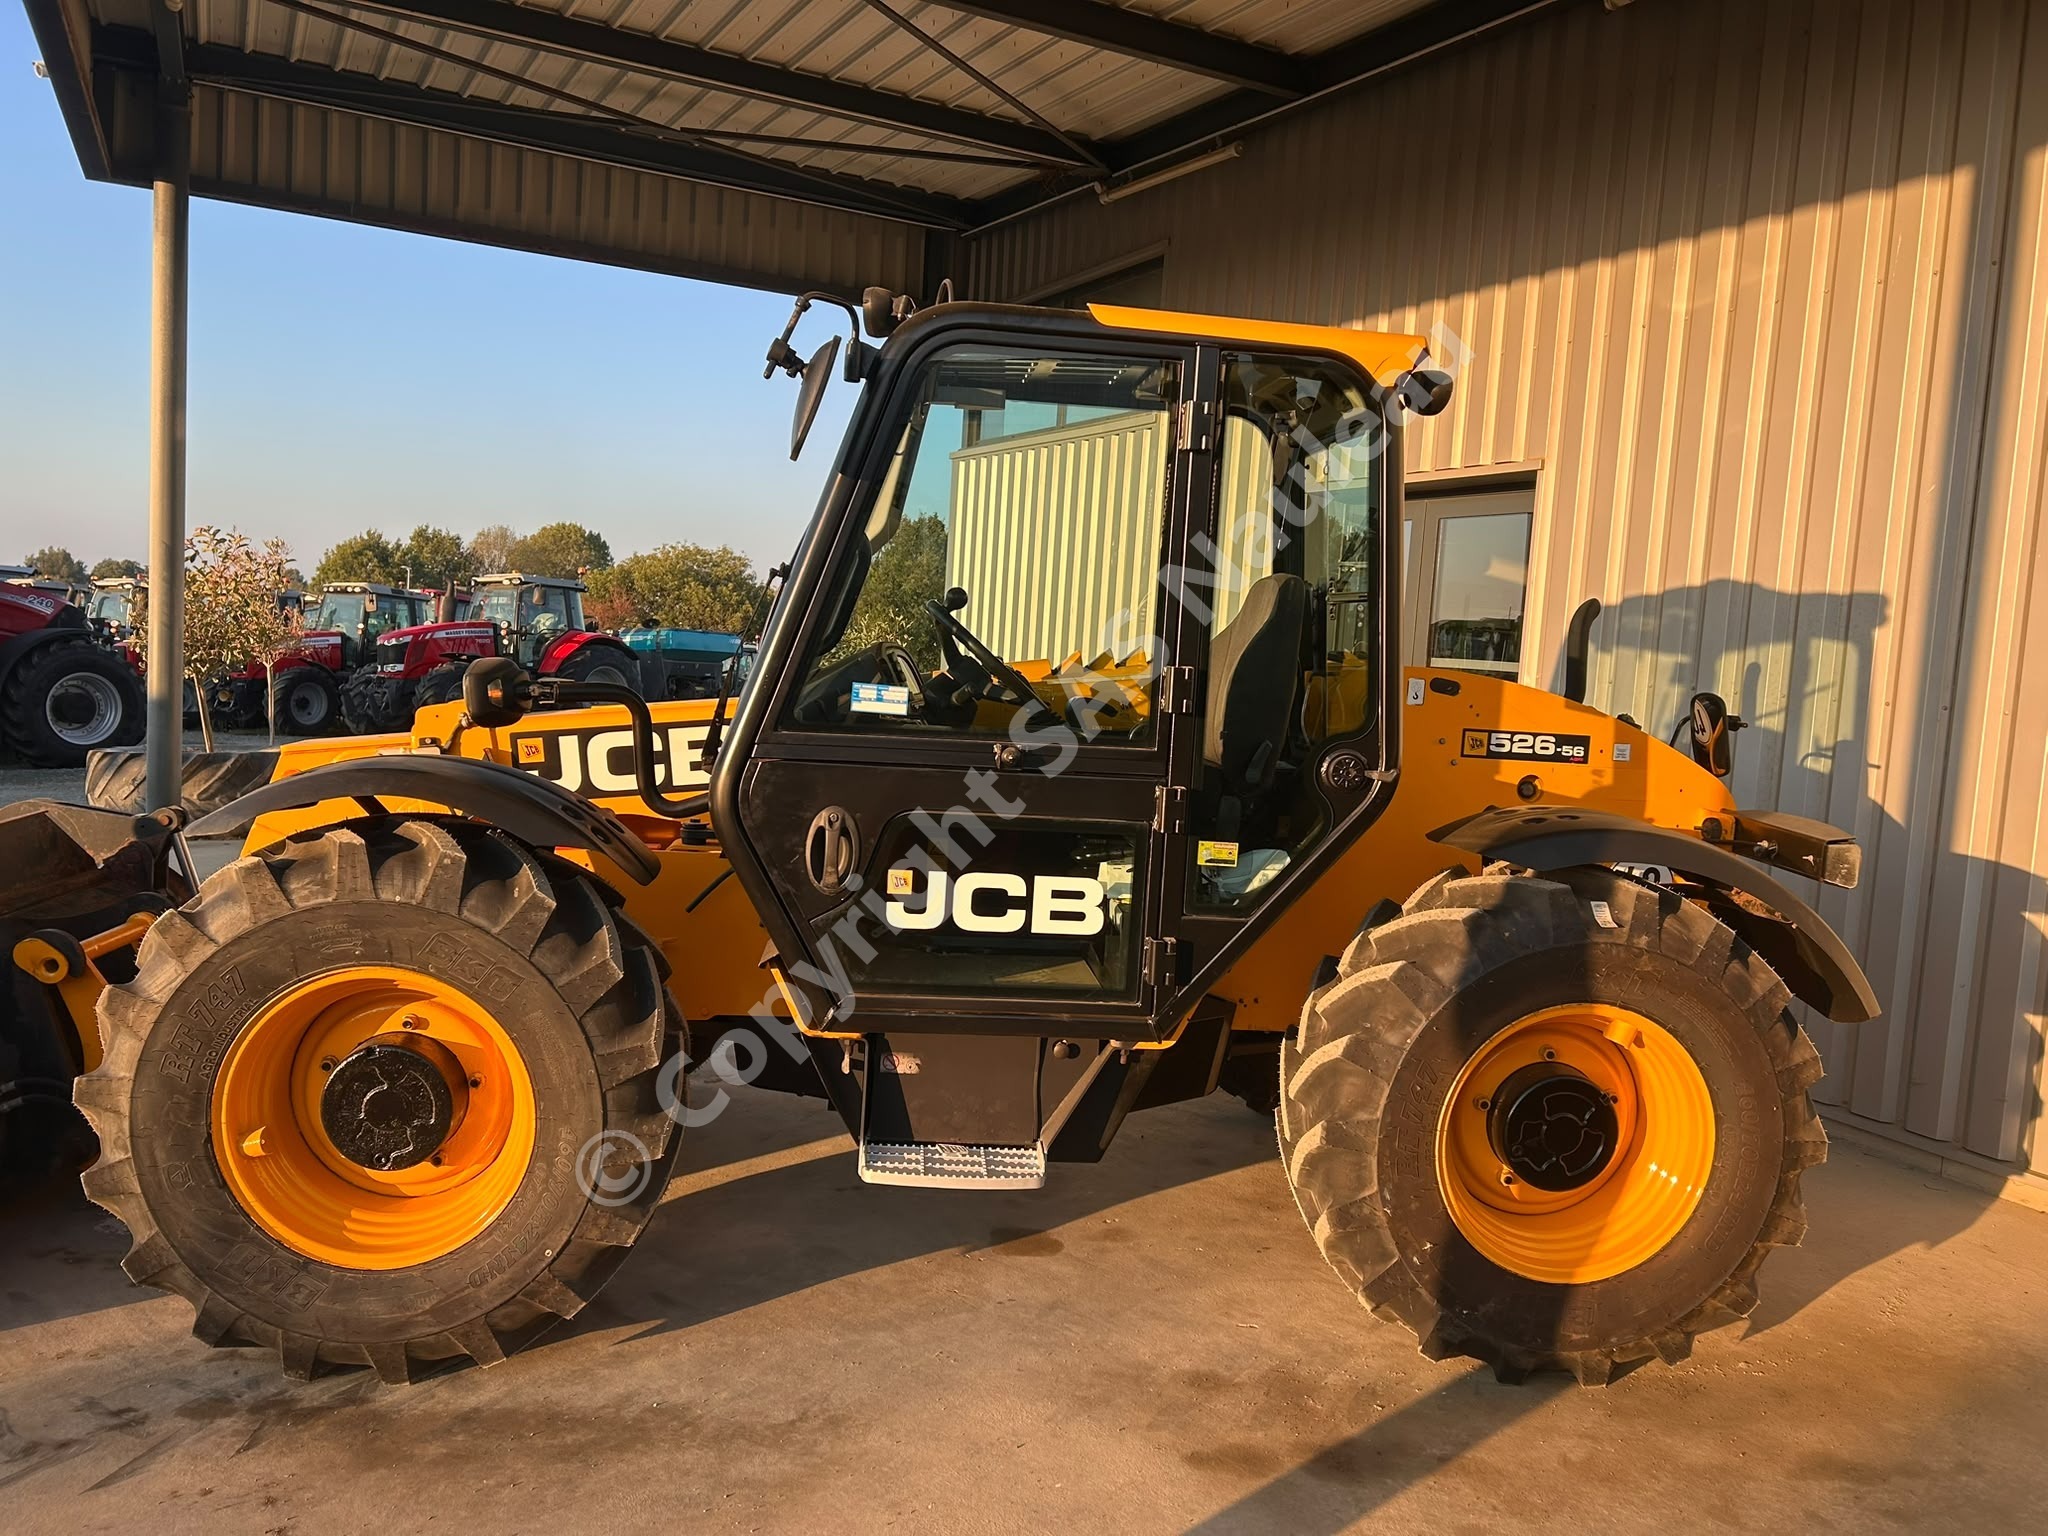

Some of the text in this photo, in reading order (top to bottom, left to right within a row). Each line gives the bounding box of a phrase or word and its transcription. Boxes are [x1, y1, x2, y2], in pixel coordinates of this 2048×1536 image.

[28, 594, 54, 609] 240
[885, 870, 1105, 936] JCB
[160, 964, 247, 1084] RT 747
[213, 999, 260, 1049] INDUSTRIAL
